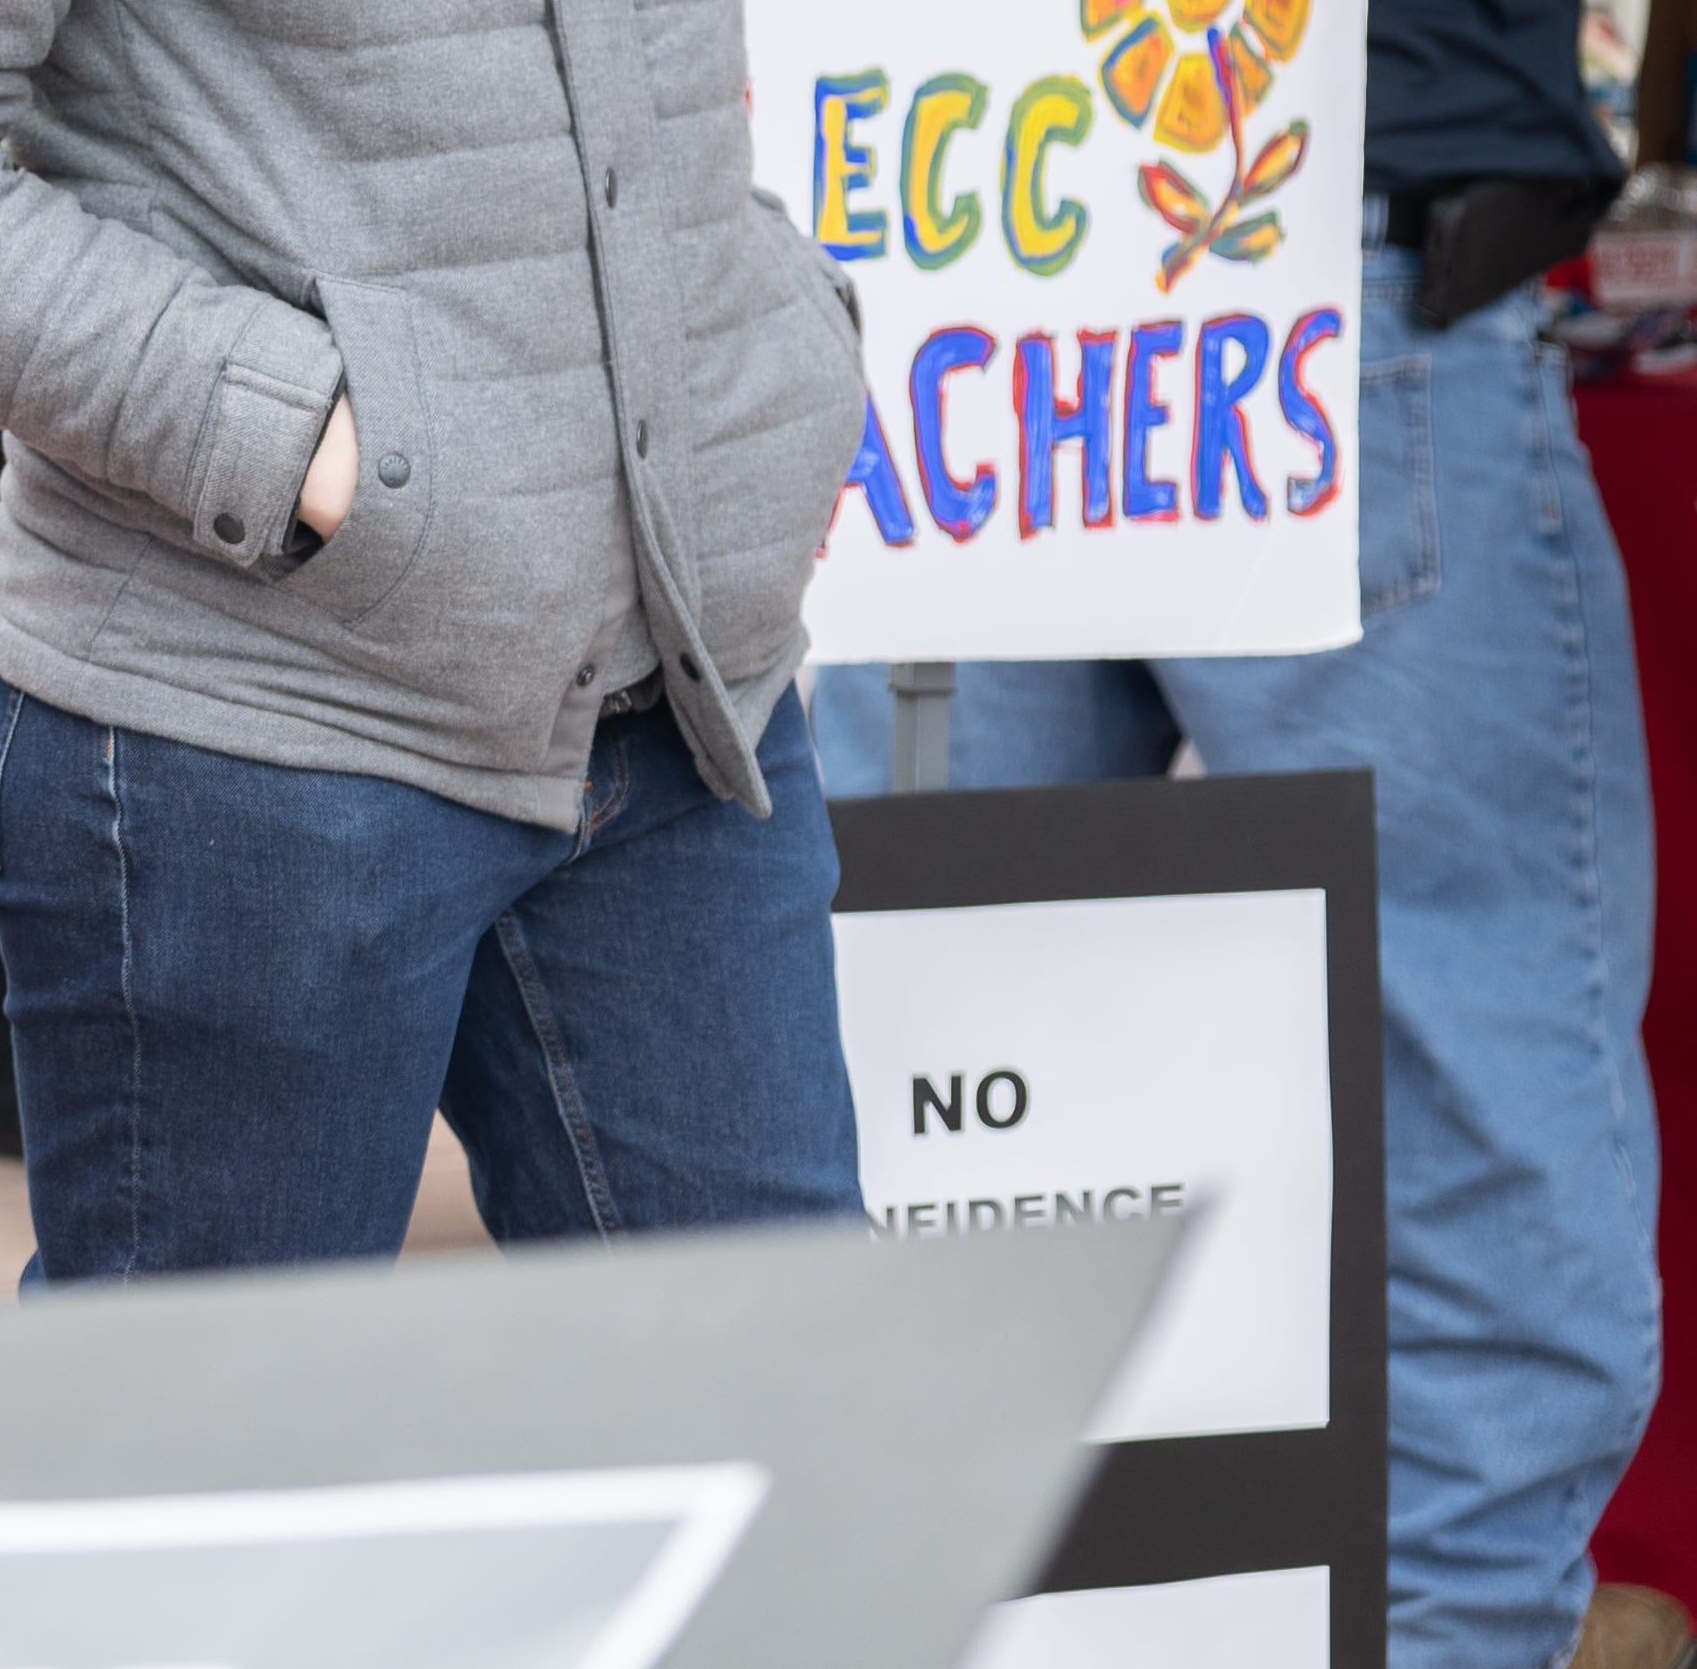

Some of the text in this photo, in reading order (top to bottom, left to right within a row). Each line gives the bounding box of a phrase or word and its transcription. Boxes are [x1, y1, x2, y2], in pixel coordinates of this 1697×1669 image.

[813, 67, 1095, 276] ECC
[813, 305, 1343, 557] ACHERS
[911, 1069, 1030, 1136] NO
